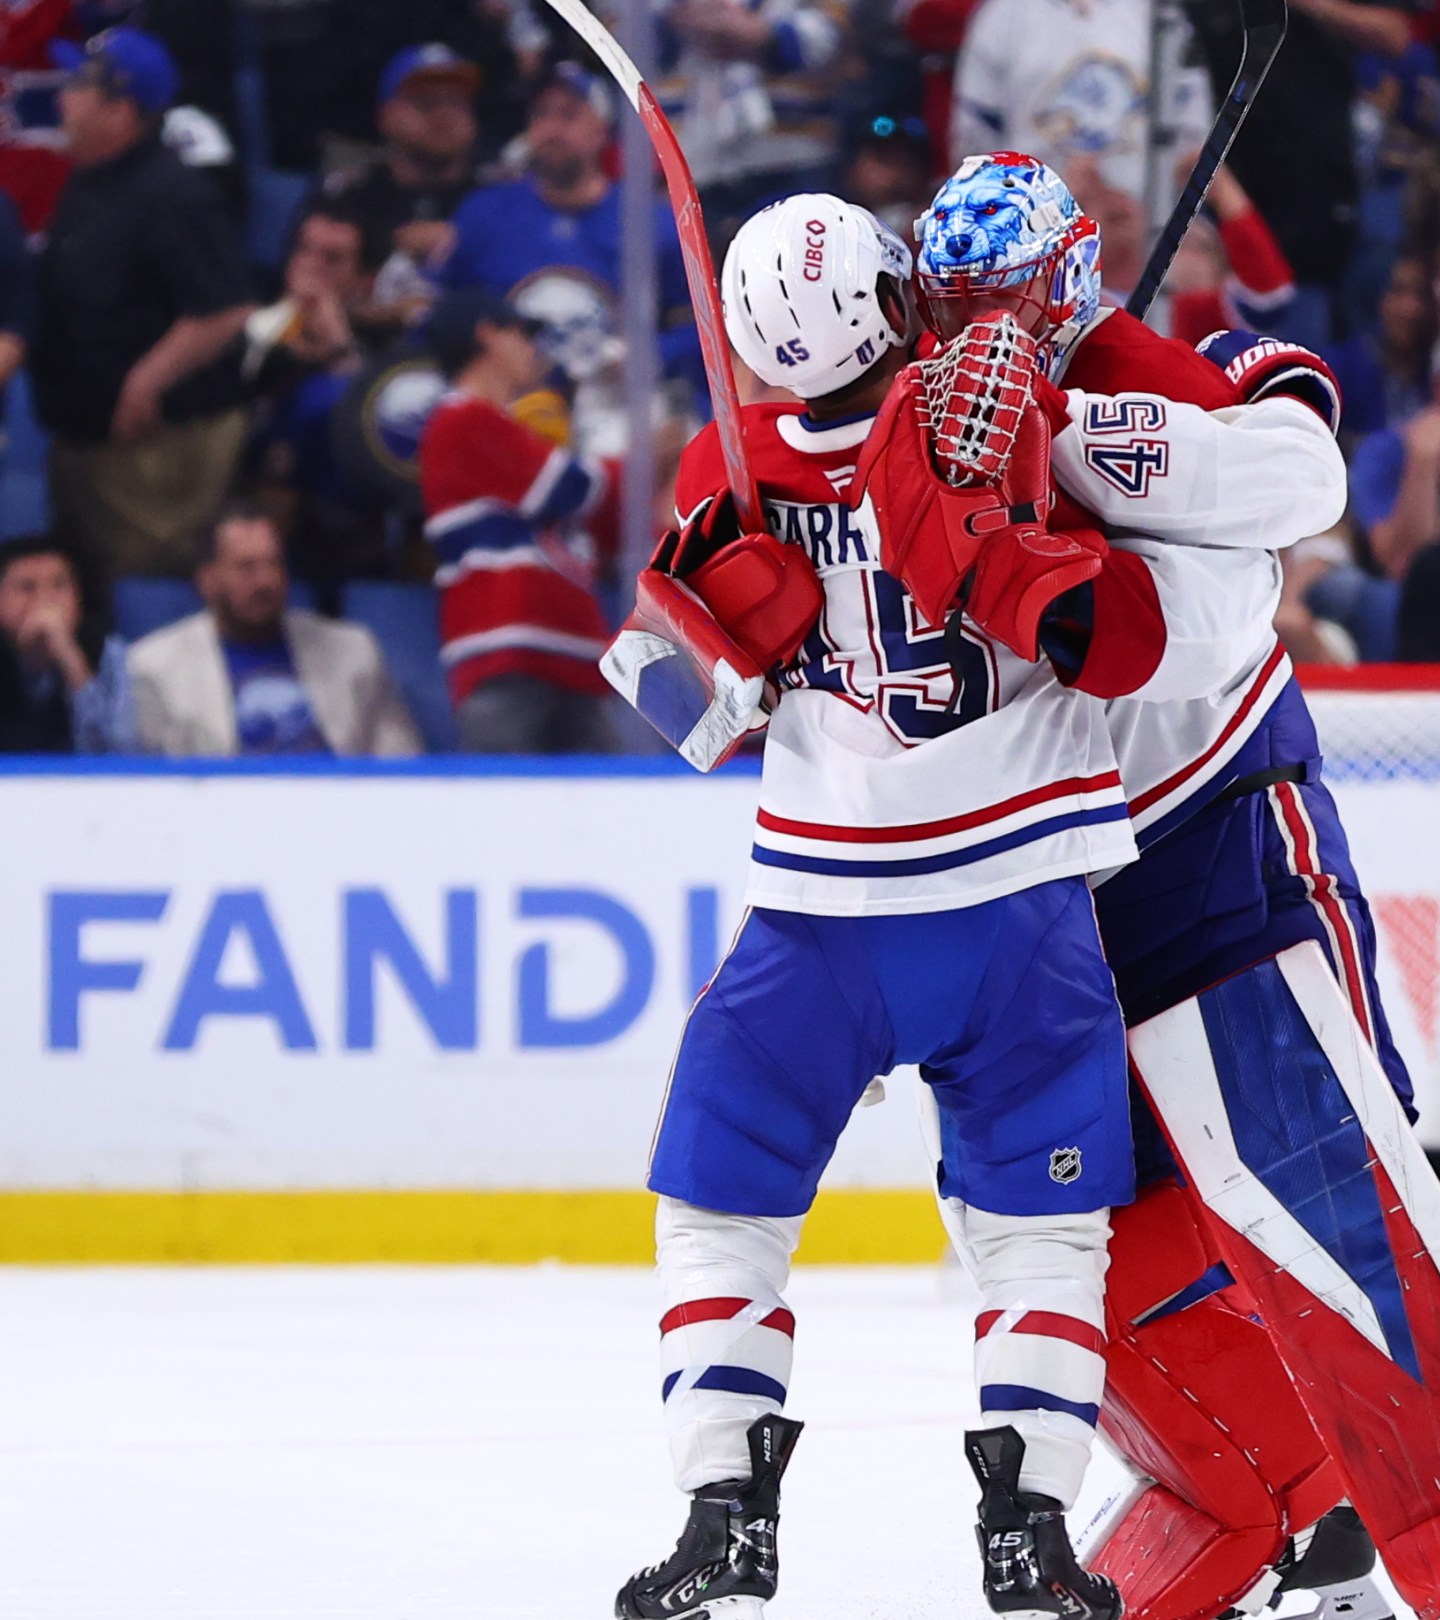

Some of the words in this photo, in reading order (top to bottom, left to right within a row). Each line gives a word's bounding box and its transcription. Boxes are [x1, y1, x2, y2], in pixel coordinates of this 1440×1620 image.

[803, 236, 825, 282] CIBC
[775, 338, 810, 368] 45
[1083, 399, 1169, 498] 45
[764, 503, 881, 569] ARR
[763, 1426, 772, 1463] CCM
[988, 1531, 1024, 1549] 45
